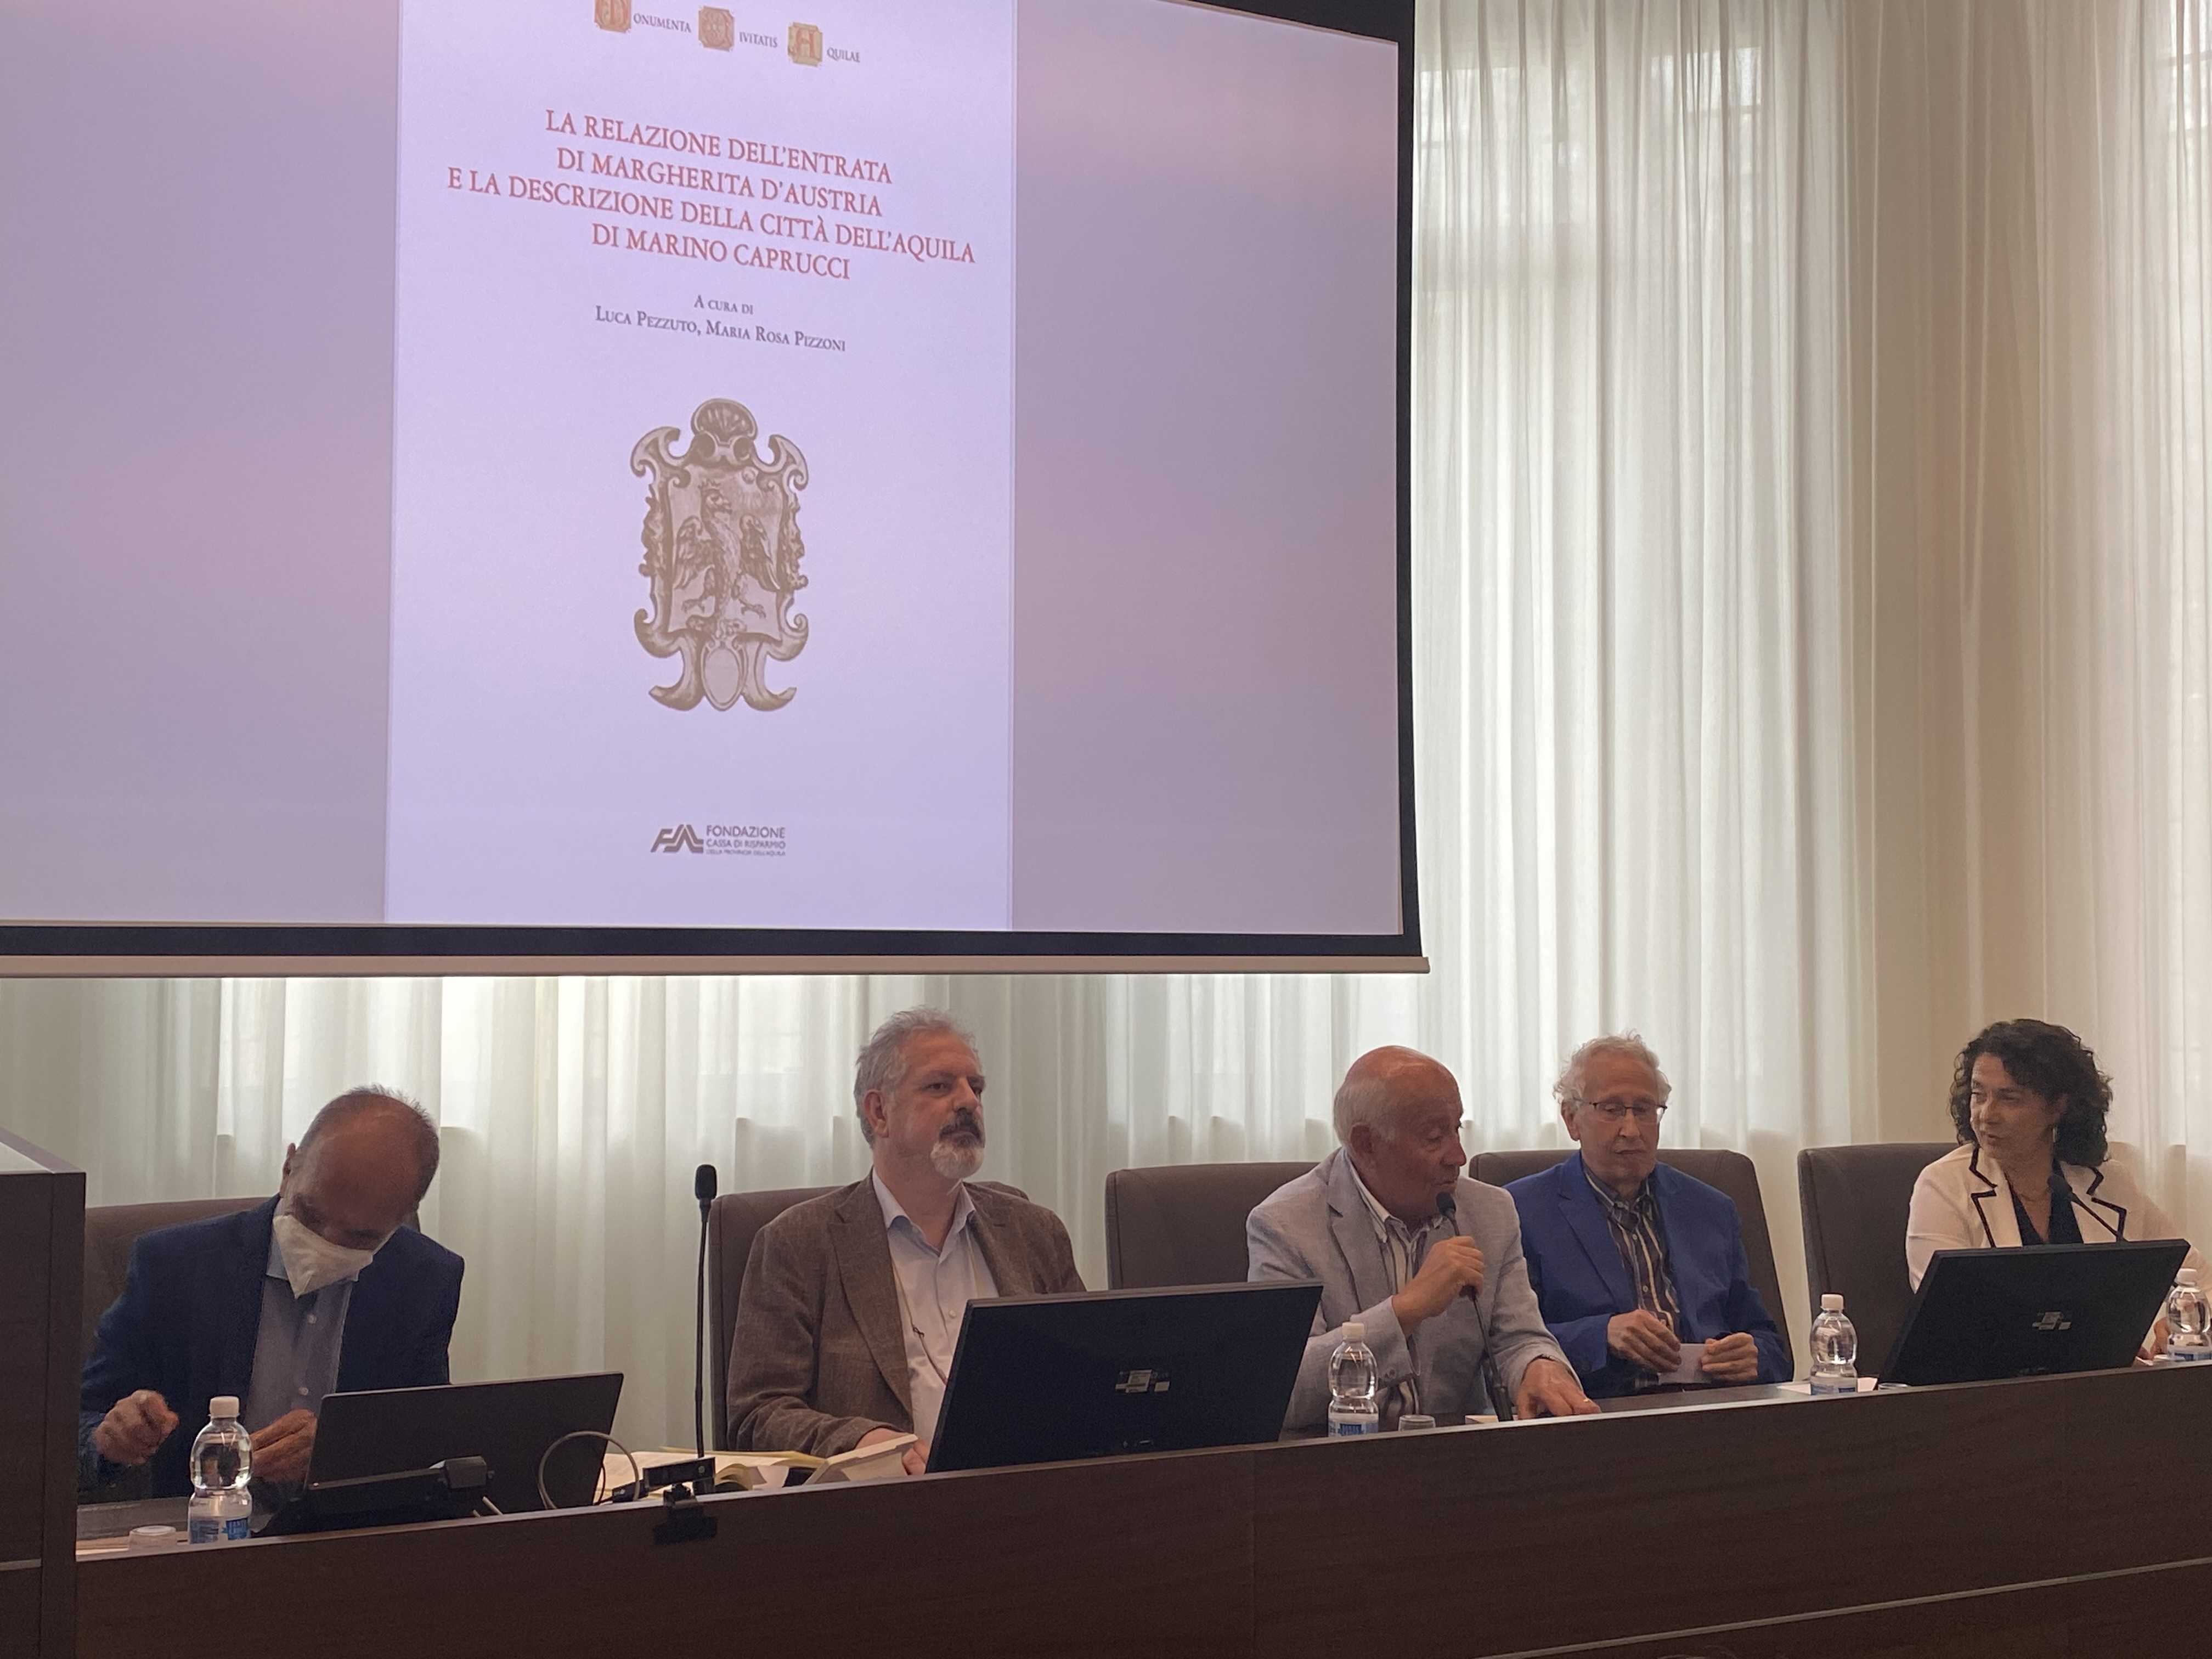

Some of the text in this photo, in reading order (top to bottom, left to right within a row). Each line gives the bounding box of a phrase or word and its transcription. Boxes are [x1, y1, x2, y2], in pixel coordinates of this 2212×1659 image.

[546, 110, 893, 185] LA RELAZIONE DELL'ENTRATA
[556, 147, 883, 217] DI MARGHERITA D'AUSTRIA
[447, 166, 975, 264] E LA DESCRIZIONE DELLA CITTÀ DELL'AQUILA
[591, 223, 850, 280] DI MARINO CAPRUCCI
[693, 294, 705, 309] A
[706, 825, 786, 838] FONDAZIONE
[706, 838, 786, 850] CASSA DI RISPARMIO
